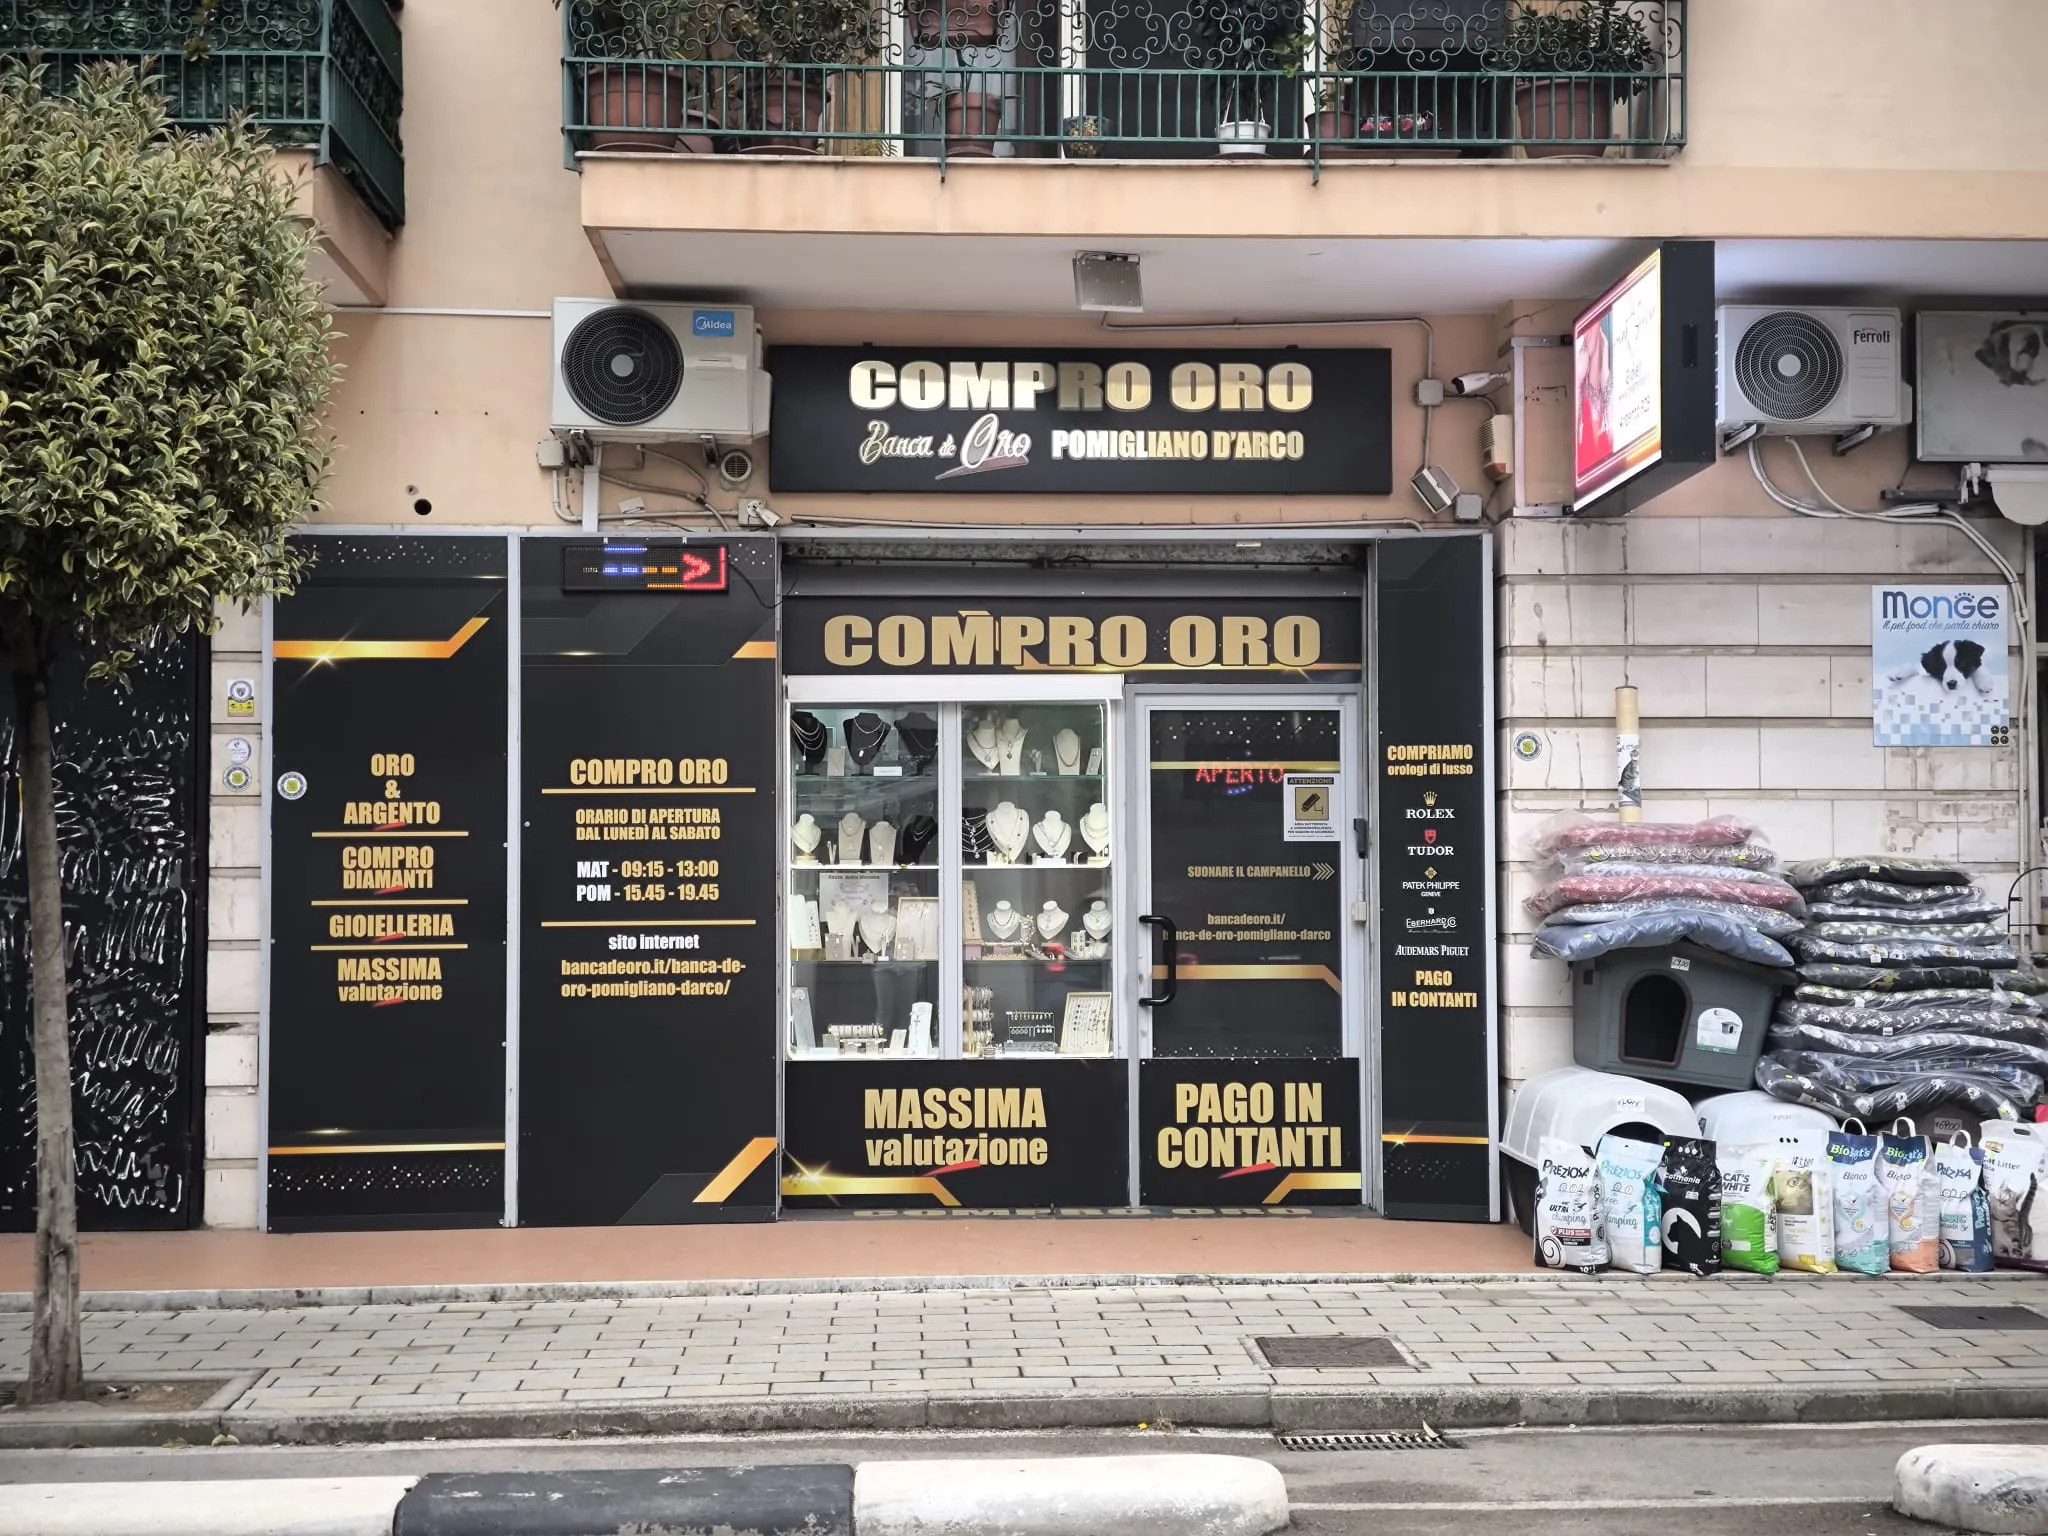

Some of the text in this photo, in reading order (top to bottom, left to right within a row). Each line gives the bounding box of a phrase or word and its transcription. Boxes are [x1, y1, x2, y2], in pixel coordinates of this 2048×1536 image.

[696, 317, 732, 330] Midea
[1853, 330, 1891, 344] Ferroli
[850, 361, 1312, 412] COMPRO ORO
[859, 412, 1305, 470] Banca de Oro POMIGLIANO D'ARCO
[1890, 620, 1905, 632] pet
[1906, 619, 1927, 632] food
[1928, 620, 1943, 630] che
[1945, 619, 1970, 632] parla
[1971, 619, 2000, 630] chiaro
[823, 613, 1322, 667] COMPRO ORO
[1387, 744, 1474, 760] COMPRIAMO
[371, 753, 415, 777] ORO
[570, 758, 728, 785] COMPRO ORO
[1195, 761, 1286, 784] APERTO
[1387, 763, 1474, 777] orologi di lusso
[384, 779, 401, 799] &
[343, 801, 441, 825] ARGENTO
[576, 808, 720, 825] ORARIO DI APERTURA
[1406, 808, 1455, 819] ROLEX
[576, 824, 721, 841] DAL LUNEDÌ AL SABATO
[342, 845, 434, 869] COMPRO
[1407, 846, 1454, 856] TUDOR
[577, 861, 610, 878] MAT
[621, 861, 664, 878] 09:15
[676, 860, 719, 877] 13:00
[1187, 865, 1311, 878] SUONARE IL CAMPANELLO
[343, 869, 433, 889] DIAMANTI
[1402, 881, 1460, 890] PATEK PHILIPPE
[577, 884, 611, 902] POM
[623, 884, 665, 901] 15.45
[677, 883, 720, 901] 19.45
[329, 914, 455, 938] GIOIELLERIA
[1207, 913, 1287, 926] bancadeoro.it/
[608, 934, 700, 950] sito internet
[1163, 929, 1332, 942] bnca-de-oro-pomigliano-darco
[1395, 945, 1470, 956] AUDEMARS PIGUET
[337, 957, 443, 982] MASSIMA
[561, 958, 747, 975] bancadeoro.it/banca-de-
[1415, 970, 1453, 986] PAGO
[338, 983, 443, 1002] valutazione
[561, 979, 731, 998] oro-pomigliano-darco/
[1391, 991, 1478, 1008] IN CONTANTI
[864, 1087, 1048, 1130] MASSIMA
[1175, 1082, 1323, 1124] PAGO IN
[865, 1133, 1048, 1167] valutazione
[1157, 1126, 1342, 1168] CONTANTI
[1542, 1159, 1590, 1179] PREZIOSA
[1723, 1173, 1750, 1183] CAT'S
